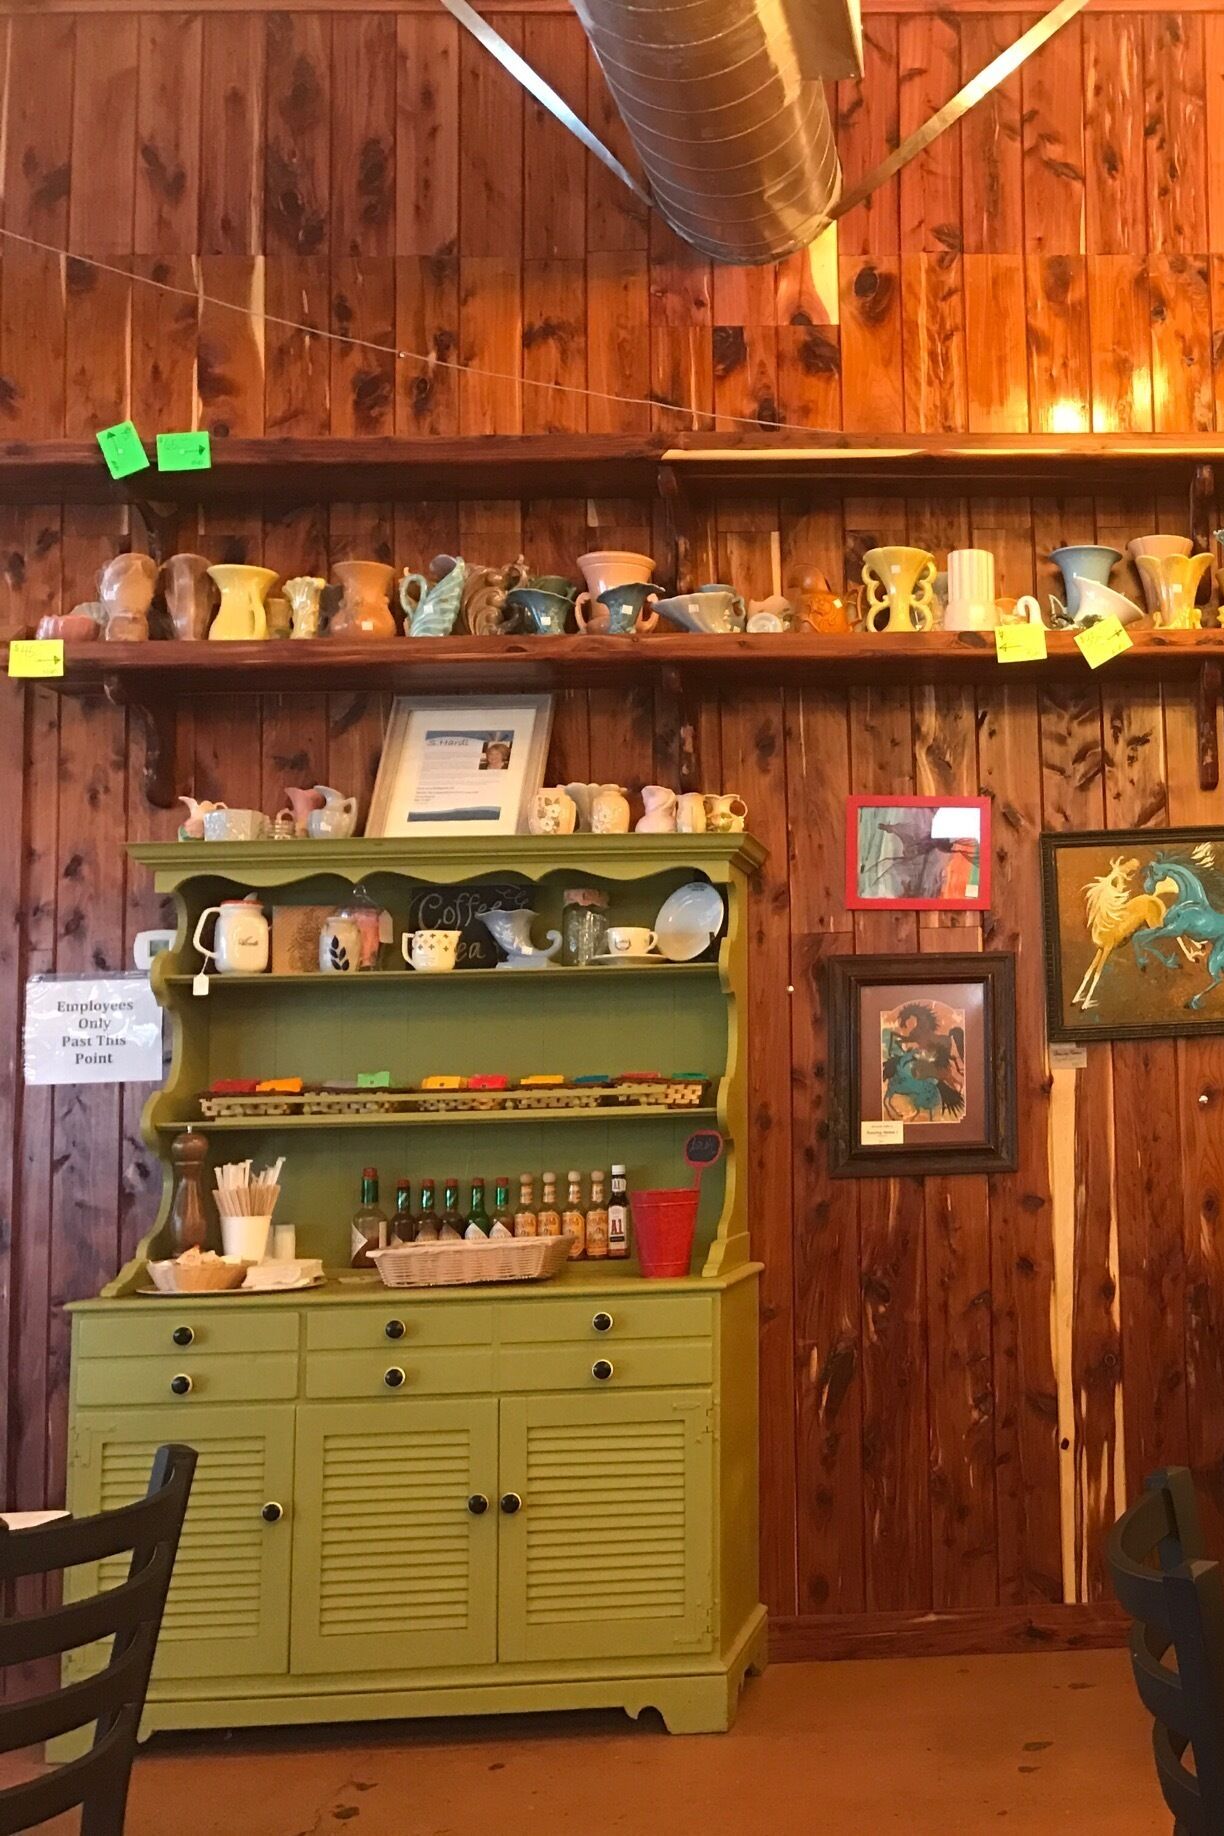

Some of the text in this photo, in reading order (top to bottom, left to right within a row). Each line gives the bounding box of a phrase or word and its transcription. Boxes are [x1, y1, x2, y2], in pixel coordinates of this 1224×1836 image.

[418, 893, 503, 930] Coffee
[455, 941, 486, 962] ea
[57, 1000, 134, 1014] Employees
[78, 1018, 111, 1031] Only
[62, 1035, 127, 1047] Past This
[75, 1052, 113, 1064] Point
